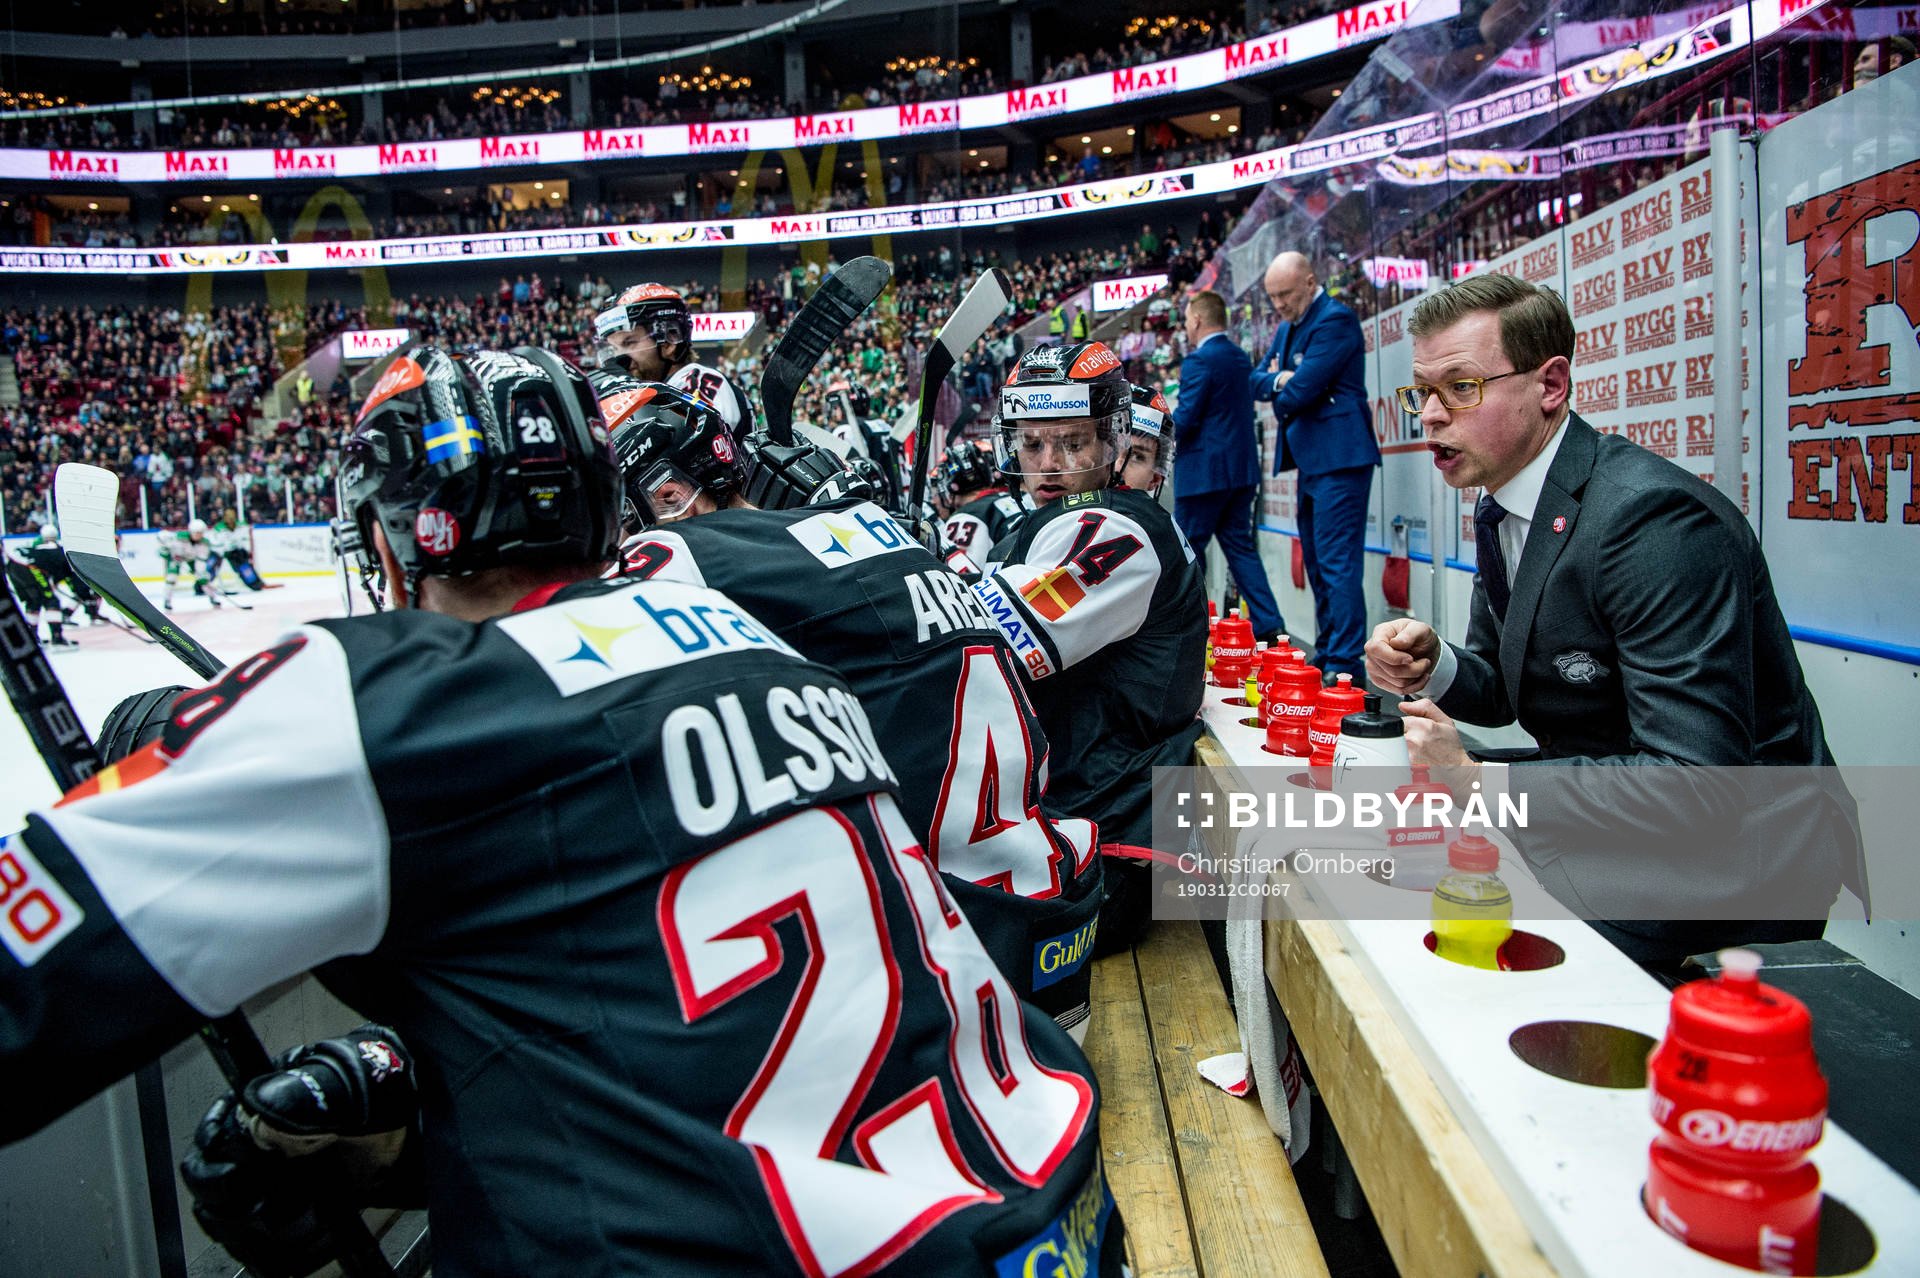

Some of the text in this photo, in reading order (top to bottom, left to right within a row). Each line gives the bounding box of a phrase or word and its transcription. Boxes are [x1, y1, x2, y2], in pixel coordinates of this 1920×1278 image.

[1337, 2, 1407, 38] MAXI
[1225, 38, 1288, 71] MAXI
[1113, 66, 1177, 93] MAXI
[1007, 87, 1067, 112] MAXI
[795, 115, 854, 138] MAXI
[899, 104, 960, 128] MAXI
[480, 137, 540, 158] MAXI
[584, 130, 643, 151] MAXI
[688, 124, 749, 146] MAXI
[50, 151, 119, 173] MAXI
[166, 151, 228, 172] MAXI
[274, 149, 335, 170] MAXI
[379, 144, 438, 164] MAXI
[1234, 157, 1284, 179] MAXI
[1621, 189, 1671, 234] BYGG
[771, 221, 820, 234] MAXI
[1571, 217, 1614, 256] RIV
[326, 247, 375, 258] MAXI
[1522, 242, 1557, 274] BYGG
[1623, 246, 1674, 287] RIV
[1573, 270, 1616, 305] BYGG
[695, 317, 745, 332] MAXI
[1625, 305, 1675, 341] BYGG
[1575, 322, 1617, 353] RIV
[1576, 374, 1618, 405] BYGG
[1626, 361, 1677, 393] RIV
[1028, 393, 1052, 403] OTTO
[1028, 400, 1089, 411] MAGNUSSON
[518, 416, 556, 444] 28
[1626, 418, 1677, 446] BYGG
[854, 512, 922, 550] br
[946, 521, 977, 547] 23
[1055, 511, 1145, 587] 14
[632, 595, 790, 654] bra
[1221, 647, 1251, 657] ENERVIT
[1310, 729, 1339, 745] ENERV
[661, 685, 900, 837] OLSSO
[1406, 831, 1441, 843] ENERVIT
[1040, 926, 1088, 974] Guld
